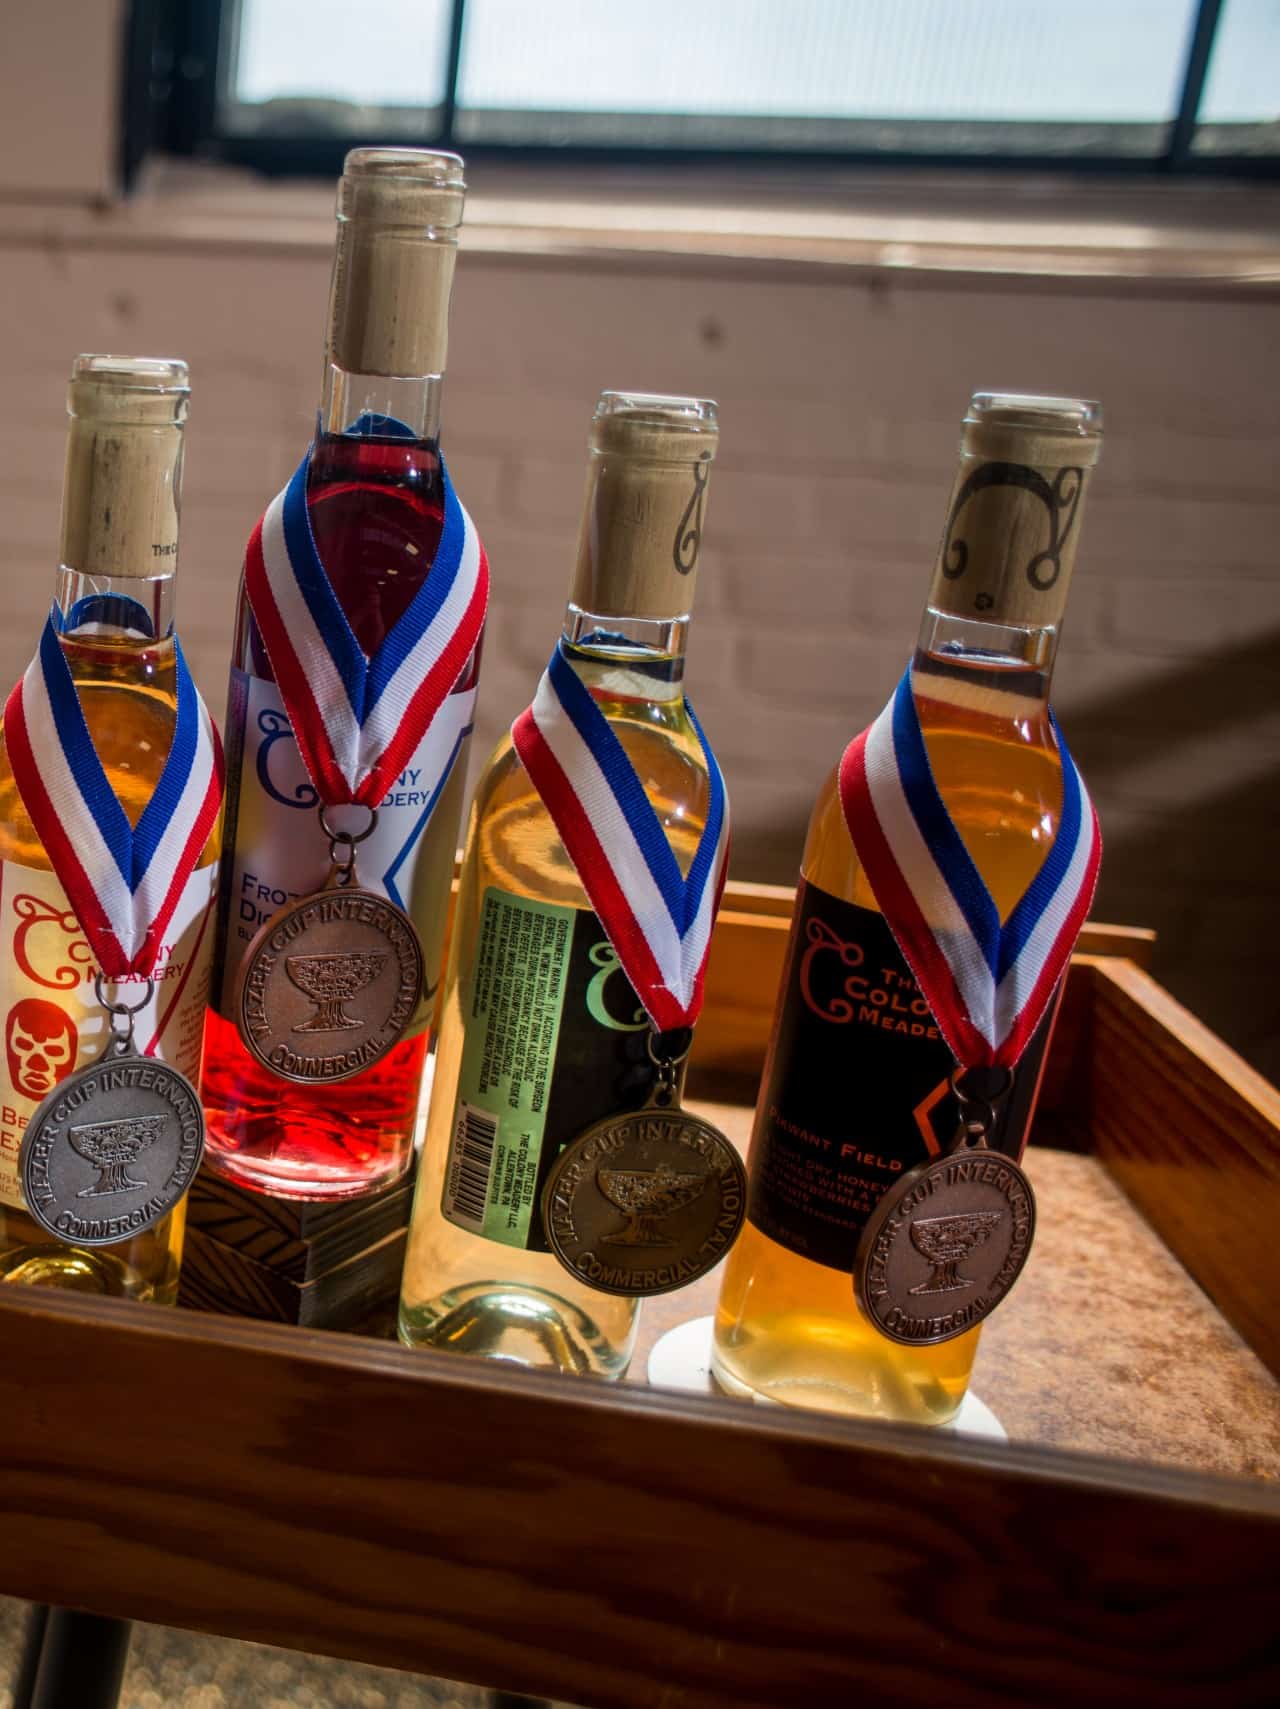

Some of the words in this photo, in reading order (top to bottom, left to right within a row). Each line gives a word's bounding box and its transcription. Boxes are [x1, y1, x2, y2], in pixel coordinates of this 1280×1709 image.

[381, 790, 430, 807] DERY
[509, 908, 522, 949] BEVERAGES
[522, 910, 533, 932] BIRTH
[531, 913, 544, 955] BEVERAGES
[554, 918, 568, 966] GOVERNMENT
[271, 910, 319, 952] CUP
[317, 899, 419, 1034] INTERNATIONAL
[527, 955, 538, 983] DURING
[540, 951, 551, 978] WOMEN
[509, 978, 524, 1027] CONSUMPTION
[521, 982, 534, 1024] PREGNANCY
[535, 978, 547, 1007] SHOULD
[844, 975, 930, 1016] COLO
[533, 1006, 543, 1022] NOT
[858, 1004, 940, 1040] MEADE
[516, 1024, 529, 1056] BECAUSE
[530, 1021, 541, 1043] DRINK
[541, 1015, 554, 1055] ACCORDING
[269, 1036, 388, 1077] COMMERCIAL
[502, 1037, 515, 1076] ALCOHOLIC
[513, 1066, 523, 1081] THE
[524, 1044, 538, 1082] ALCOHOLIC
[537, 1065, 547, 1081] THE
[510, 1080, 520, 1098] RISK
[532, 1080, 545, 1113] SURGEON
[1, 1105, 30, 1130] BE
[55, 1079, 98, 1122] CUP
[102, 1067, 200, 1195] INTERNATIONAL
[519, 1132, 529, 1148] THE
[840, 1143, 903, 1171] FIELD
[515, 1148, 527, 1179] COLONY
[523, 1161, 535, 1195] BOTTLED
[510, 1179, 522, 1213] MEADERY
[639, 1120, 741, 1257] INTERNATIONAL
[57, 1195, 170, 1240] COMMERCIAL
[576, 1251, 700, 1288] COMMERCIAL
